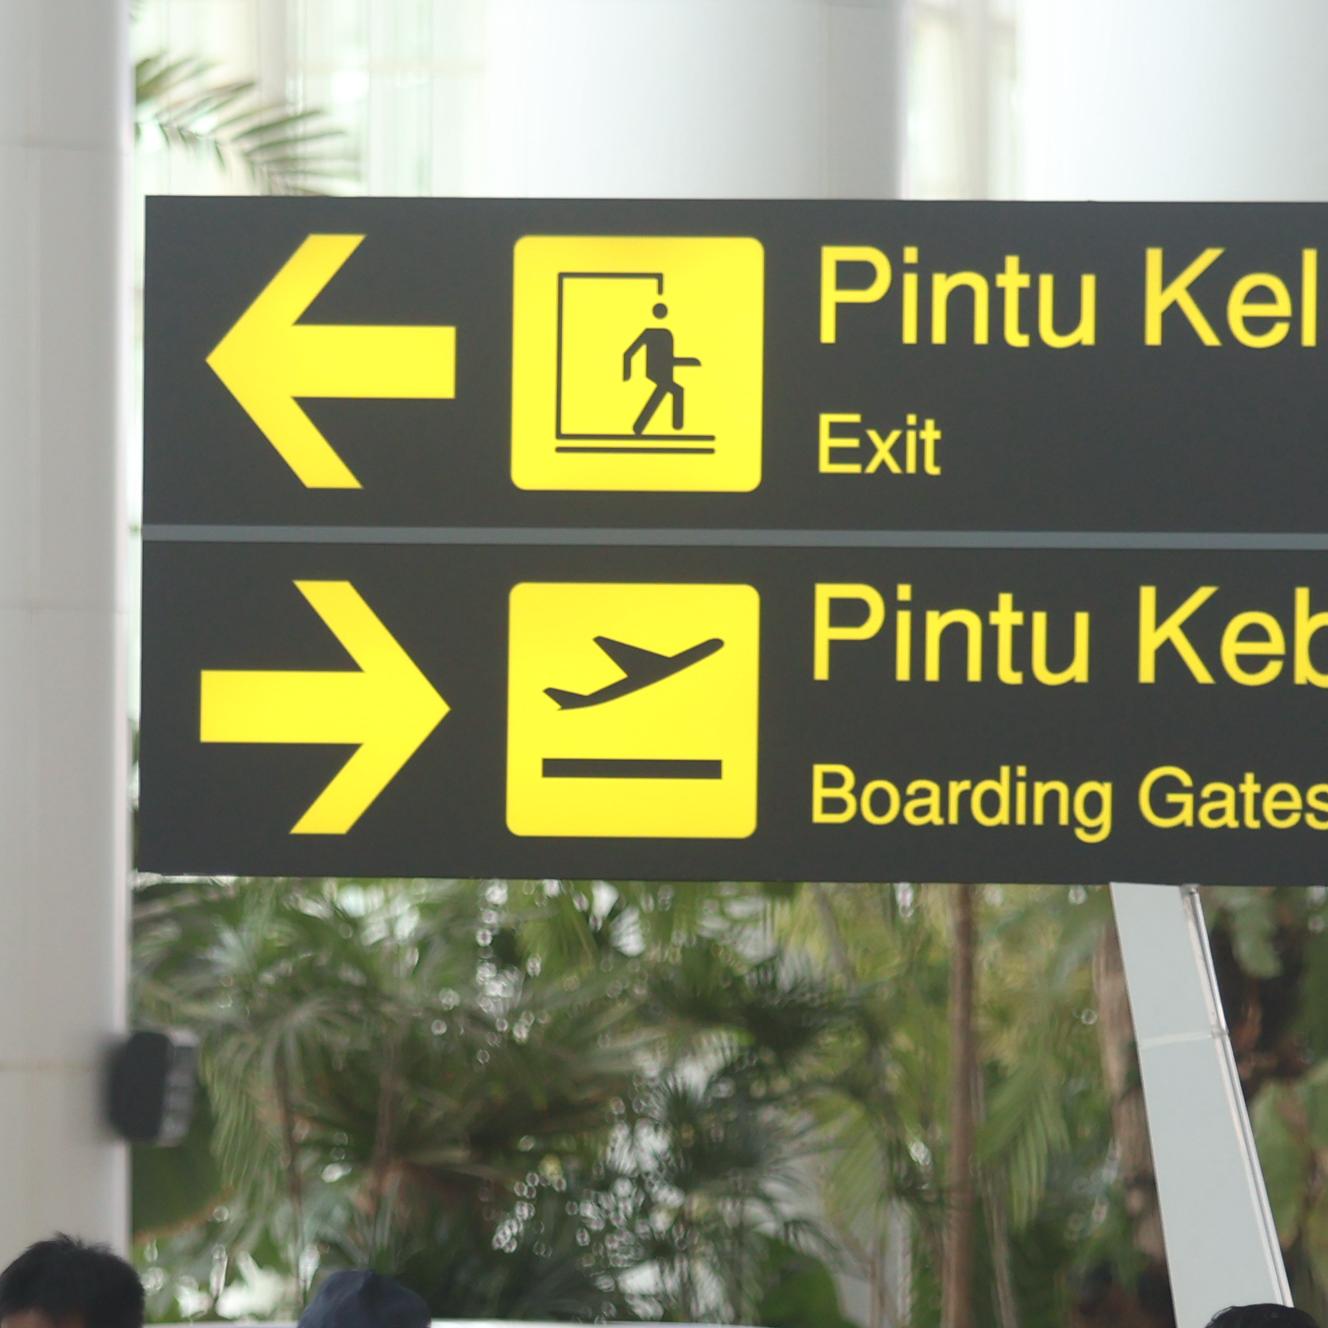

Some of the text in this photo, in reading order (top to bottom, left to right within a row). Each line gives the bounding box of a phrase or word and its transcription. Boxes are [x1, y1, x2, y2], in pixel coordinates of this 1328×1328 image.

[819, 244, 1097, 349] Pintu
[817, 412, 943, 476] Exit
[812, 582, 1091, 686] Pintu
[811, 762, 1114, 844] Boarding
